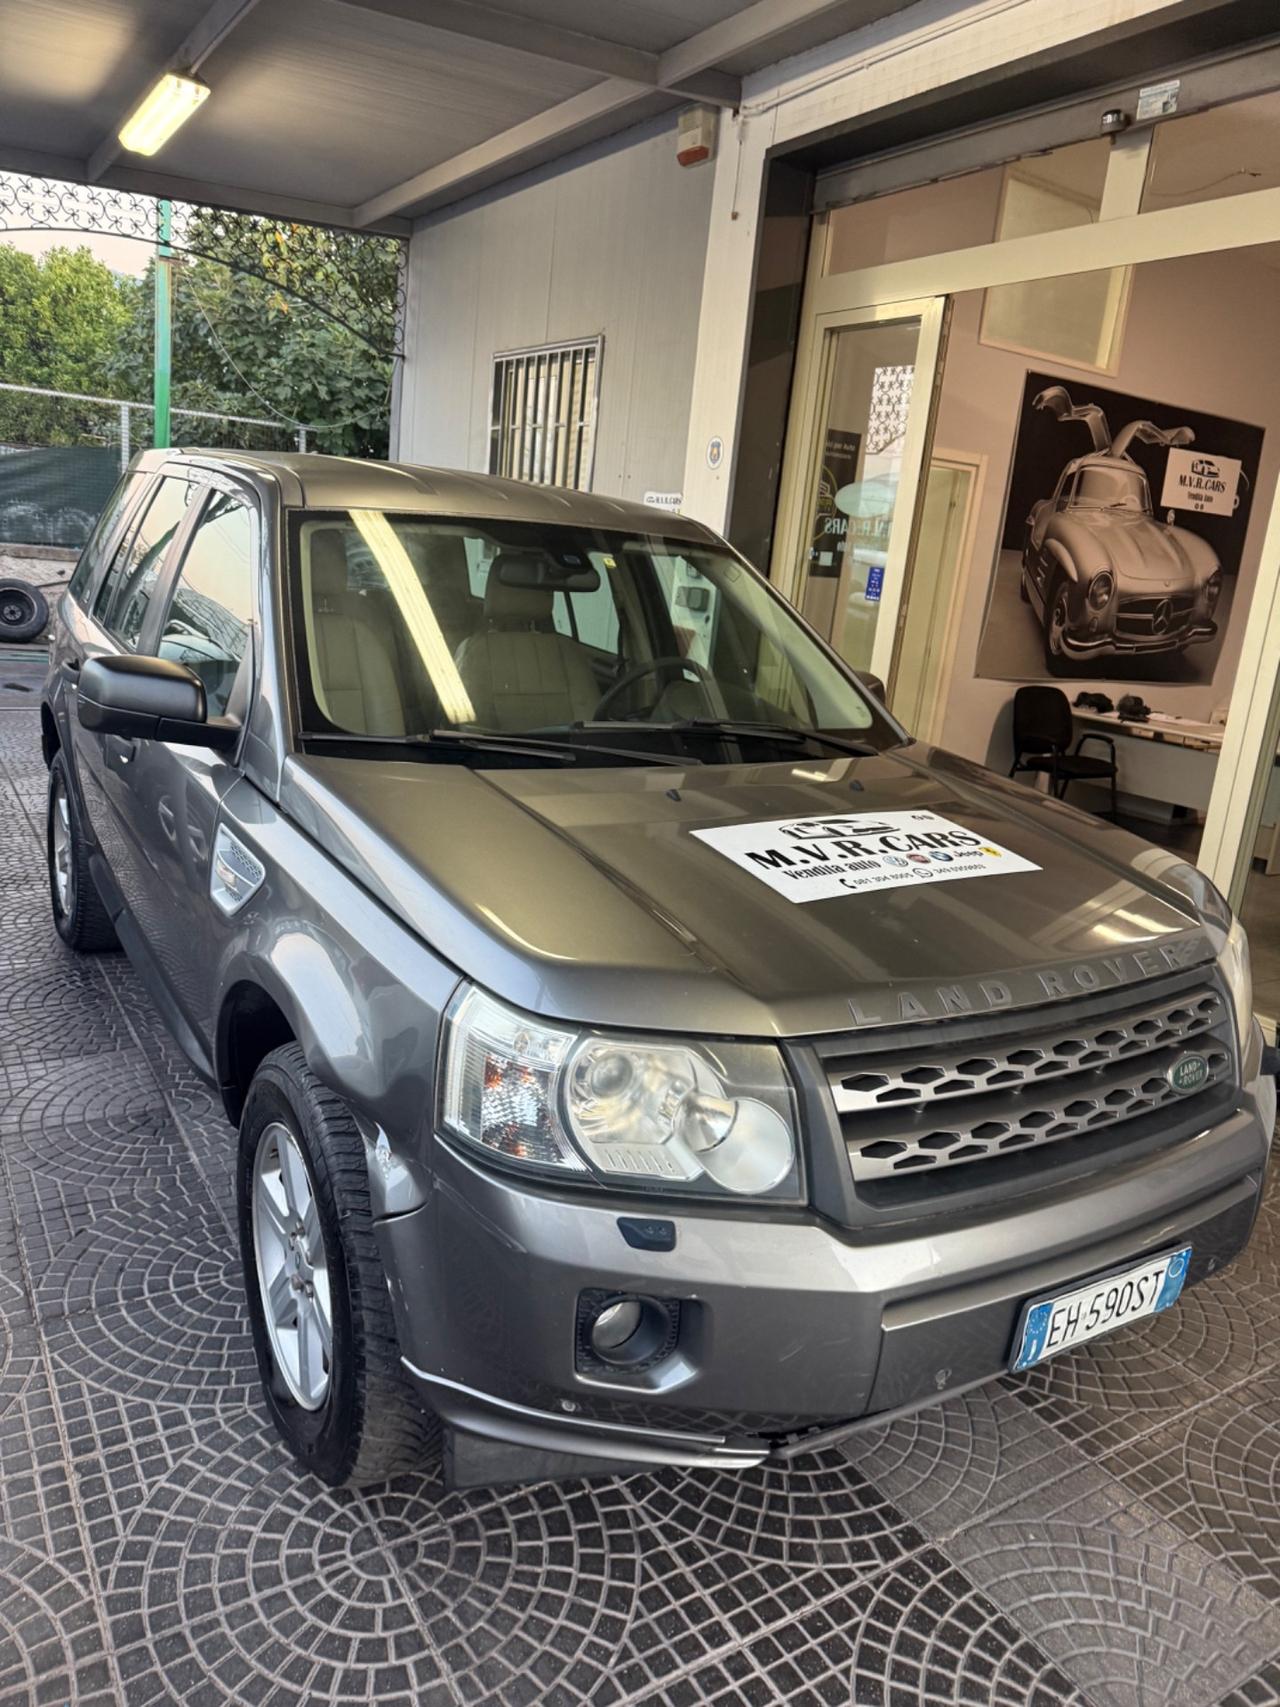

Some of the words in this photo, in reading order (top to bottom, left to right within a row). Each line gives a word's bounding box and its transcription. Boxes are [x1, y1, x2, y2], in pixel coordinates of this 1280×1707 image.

[848, 979, 1012, 1026] LAND
[1037, 944, 1187, 1000] ROVER
[1046, 1301, 1082, 1348] EH
[1085, 1269, 1165, 1331] 590ST
